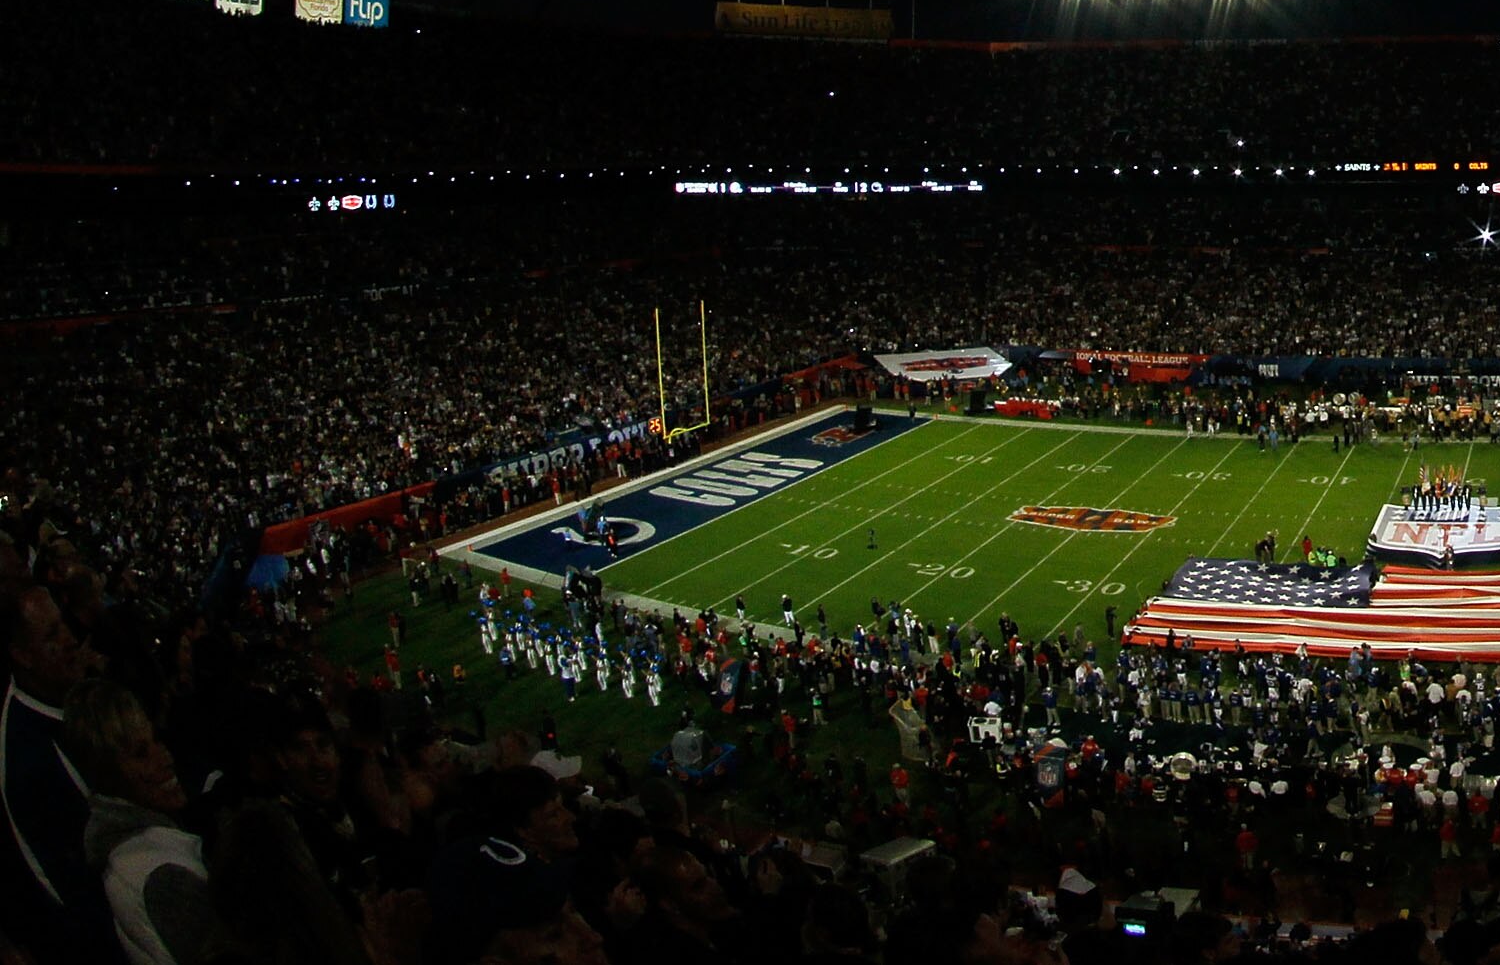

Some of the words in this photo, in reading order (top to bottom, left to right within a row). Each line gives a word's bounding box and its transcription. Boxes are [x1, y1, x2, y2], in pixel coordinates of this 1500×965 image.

[1344, 163, 1371, 172] SAINTS
[1469, 162, 1489, 171] COLTS
[649, 418, 661, 433] 25
[648, 452, 824, 507] COLTS
[790, 544, 839, 560] 10
[916, 563, 975, 579] 20
[1066, 579, 1127, 596] 30
